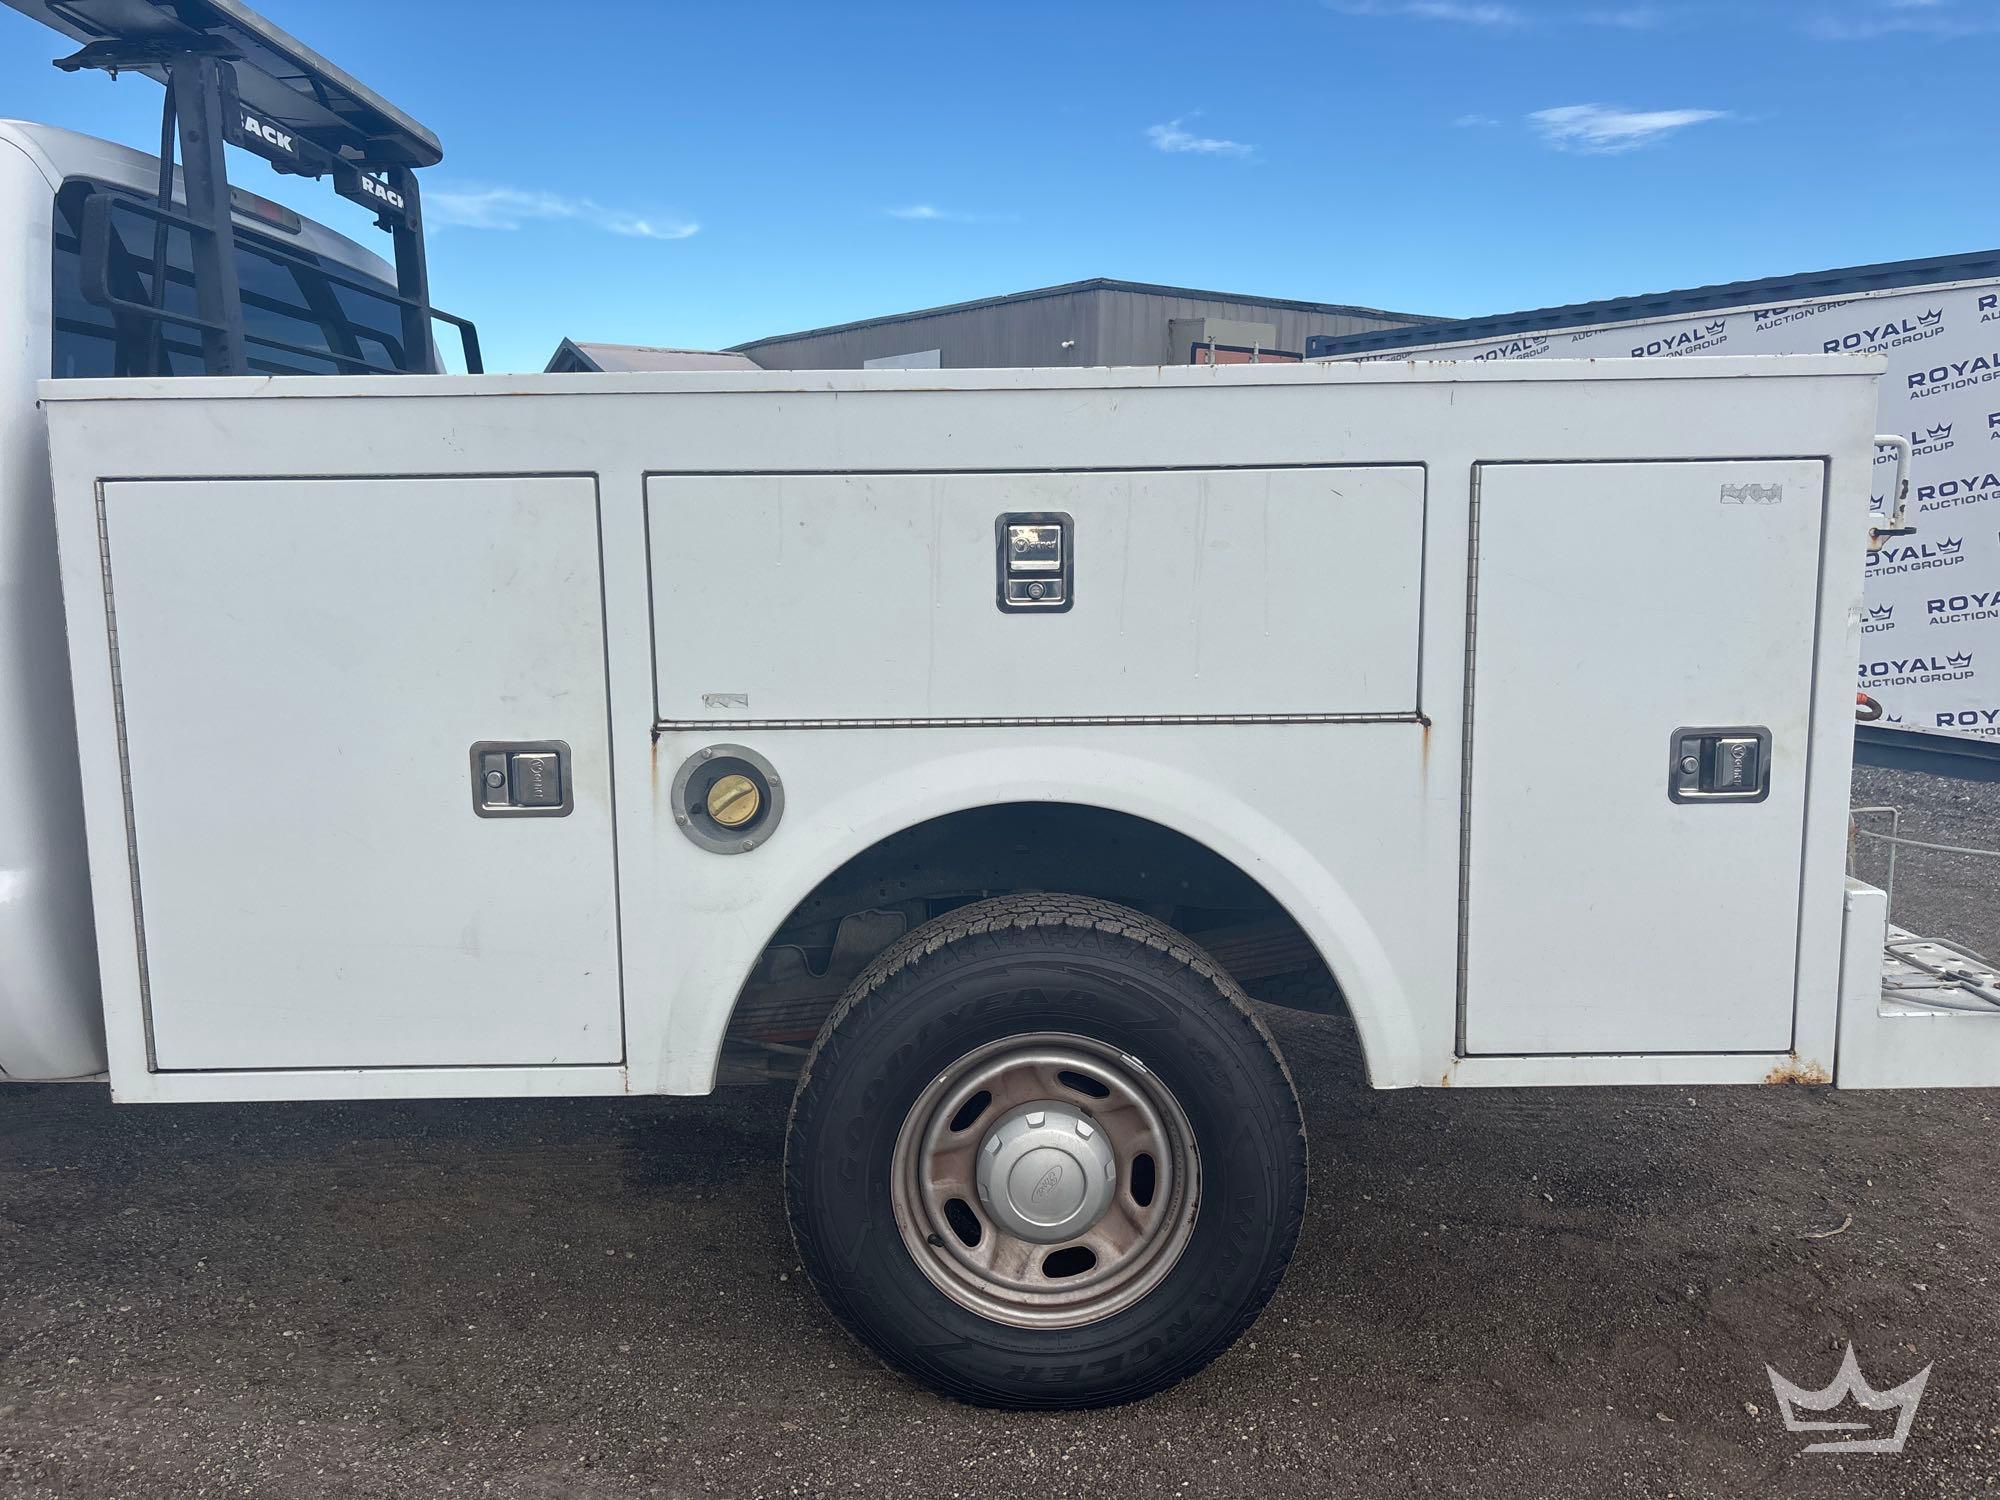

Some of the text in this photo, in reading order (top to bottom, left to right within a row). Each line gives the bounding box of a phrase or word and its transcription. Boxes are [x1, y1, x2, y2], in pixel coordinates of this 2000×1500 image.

[240, 112, 293, 152] ACK
[1756, 308, 1815, 332] AUCTION
[1685, 335, 1727, 354] GROUP
[1823, 319, 1917, 354] ROYAL
[1891, 326, 1945, 347] GROUP
[1910, 376, 1978, 400] AUCTION
[1911, 441, 1955, 457] ROUP
[1917, 473, 2000, 502] ROYA
[1919, 492, 1989, 513] AUCTION
[1864, 555, 1965, 578] CTION GROUP
[1865, 544, 1937, 567] OYAL
[1929, 609, 1999, 626] AUCTION
[1920, 670, 1975, 684] GROUP
[1936, 709, 2000, 727] ROY
